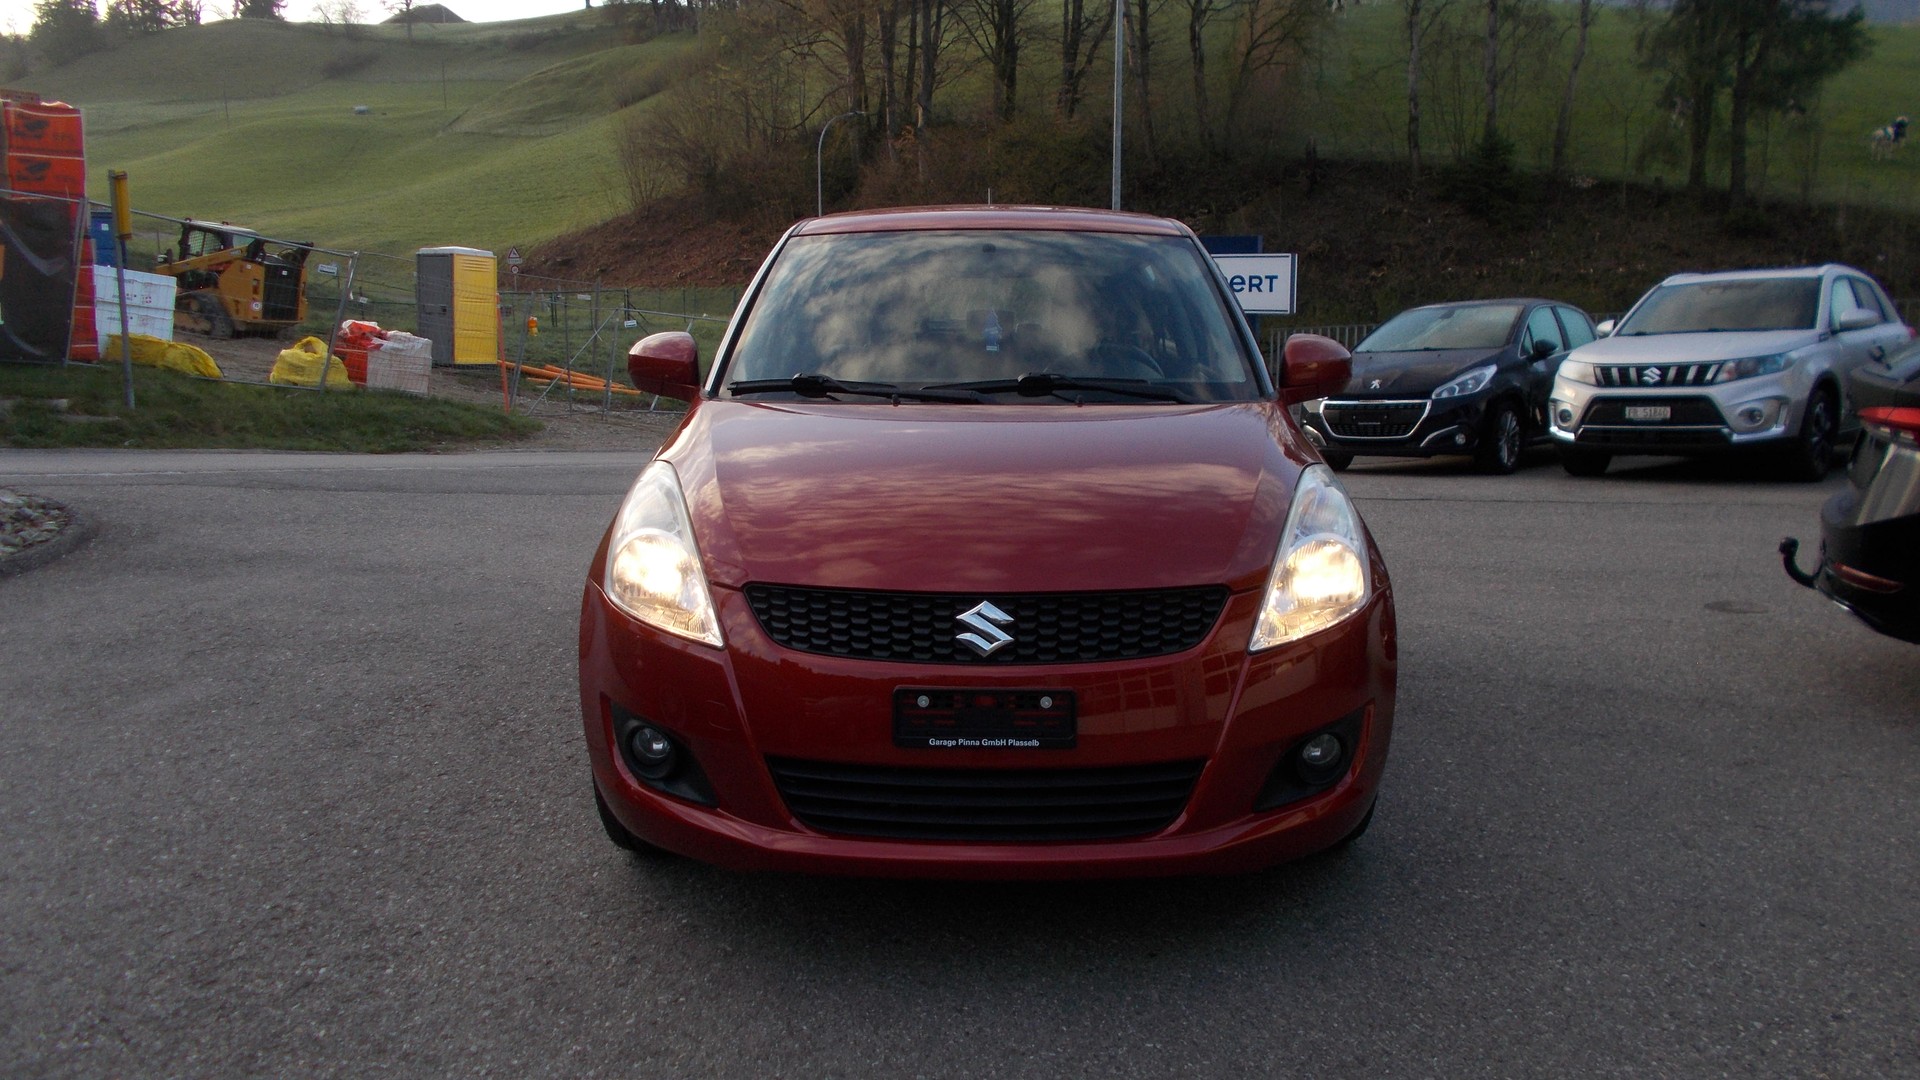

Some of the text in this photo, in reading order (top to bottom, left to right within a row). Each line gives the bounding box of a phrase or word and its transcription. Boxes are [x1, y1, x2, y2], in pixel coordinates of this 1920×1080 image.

[929, 738, 1040, 747] Garage Pinna GmbH Plasselb
